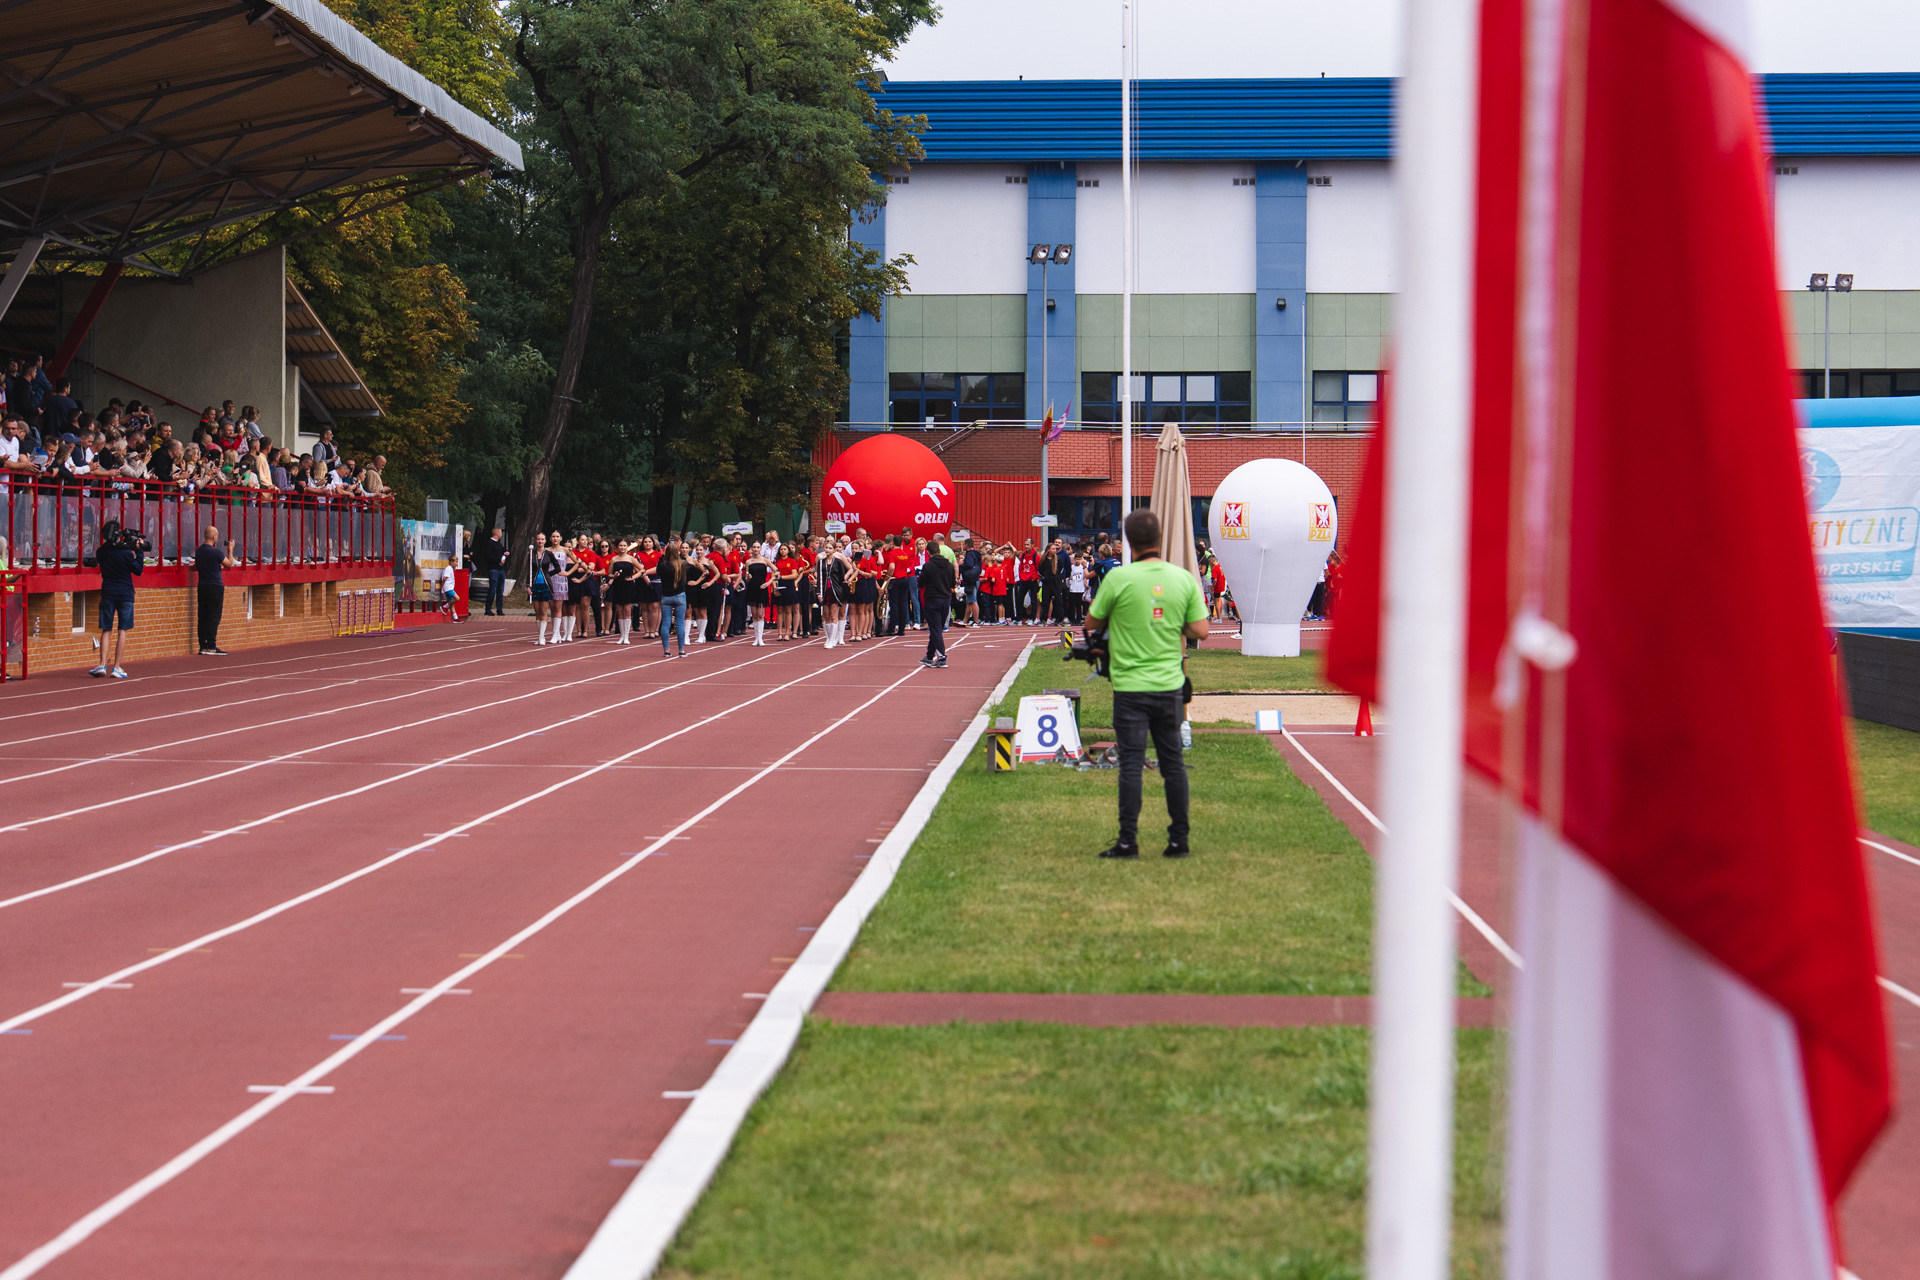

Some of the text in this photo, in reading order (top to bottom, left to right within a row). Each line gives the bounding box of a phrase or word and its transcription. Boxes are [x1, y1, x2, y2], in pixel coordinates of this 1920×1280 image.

[827, 512, 860, 523] ORLEN
[914, 512, 949, 524] ORLEN
[1221, 527, 1248, 539] PZLA
[1809, 516, 1907, 547] ETYCZNE
[1814, 560, 1903, 576] MPIJSKIE
[1823, 592, 1852, 605] ekkiej
[1037, 714, 1059, 747] 8
